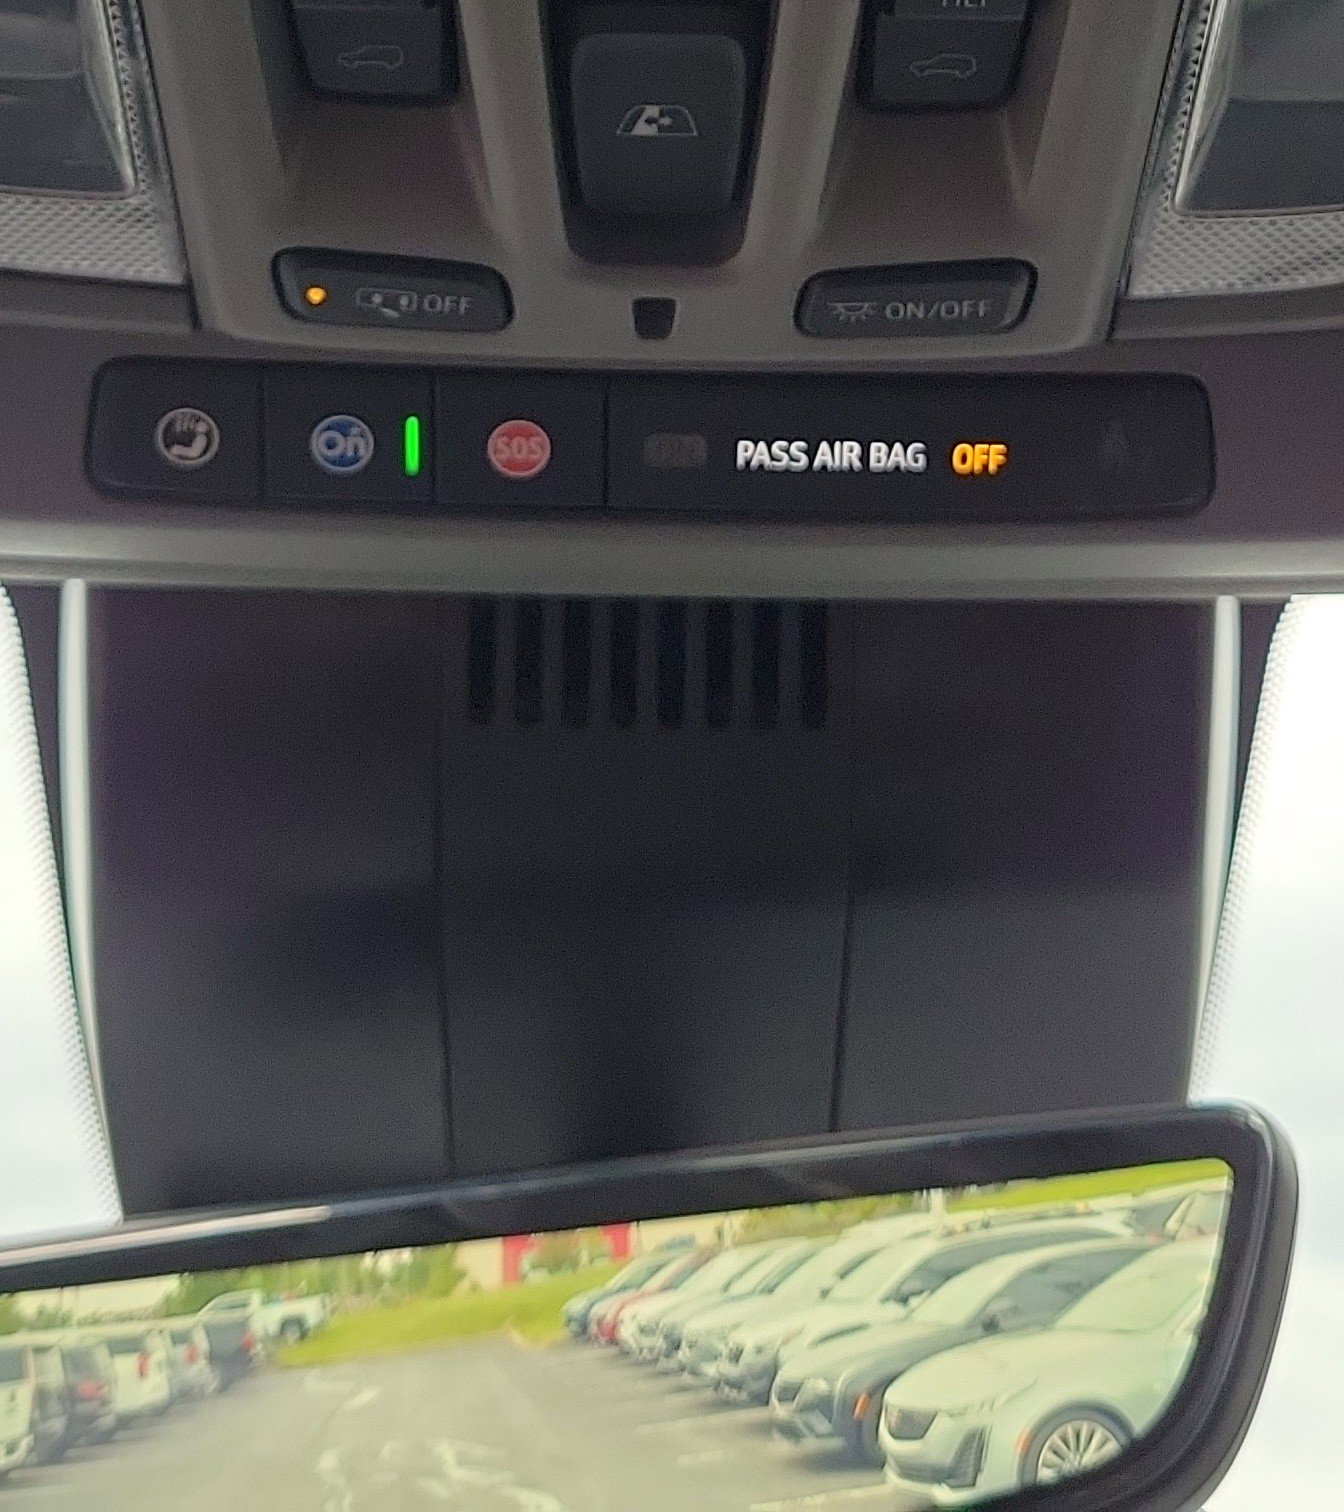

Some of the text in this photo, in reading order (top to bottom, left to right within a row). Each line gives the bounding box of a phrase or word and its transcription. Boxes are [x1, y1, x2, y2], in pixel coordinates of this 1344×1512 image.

[422, 292, 473, 315] OFF
[884, 299, 991, 321] ON/OFF
[494, 436, 544, 461] SOS
[737, 440, 809, 473] PASS
[813, 440, 862, 473] AIR
[869, 441, 927, 474] BAG
[951, 442, 1008, 476] OFF
